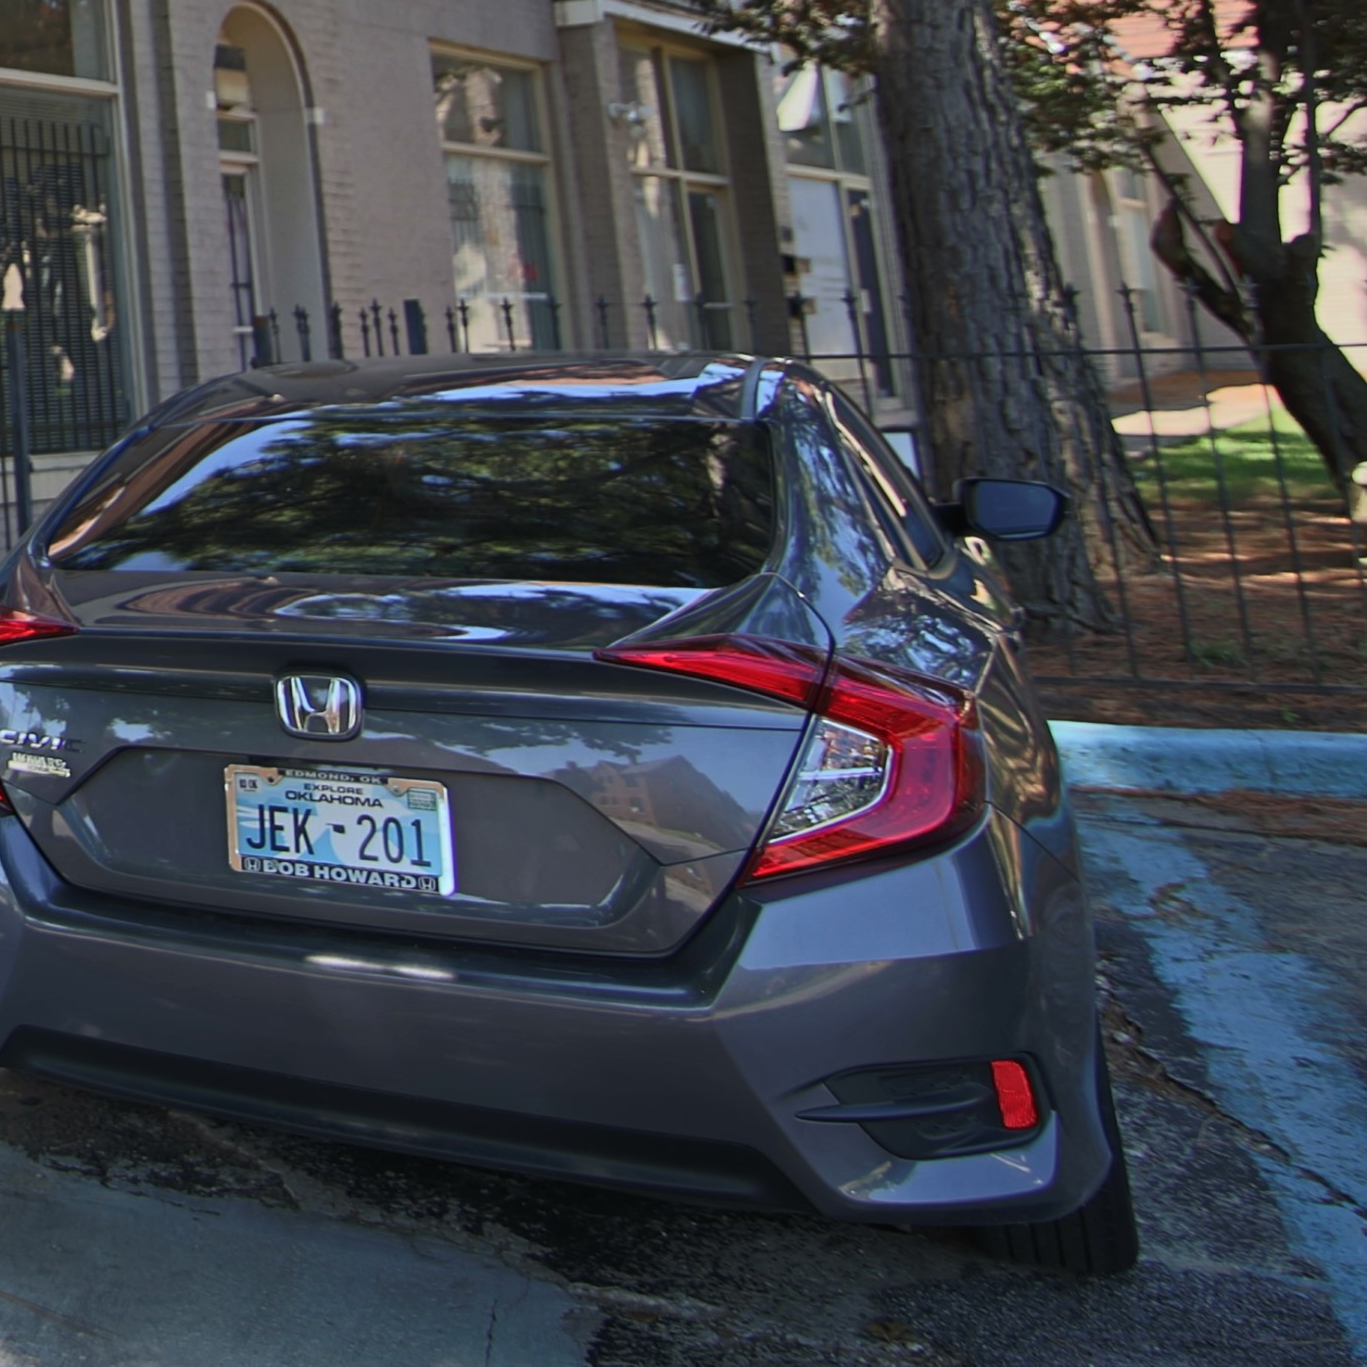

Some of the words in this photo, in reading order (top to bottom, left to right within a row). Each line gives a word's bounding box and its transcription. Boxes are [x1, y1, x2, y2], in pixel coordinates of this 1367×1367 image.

[285, 768, 354, 782] EDMOND,
[359, 775, 383, 784] OK
[303, 783, 364, 795] EXPLORE
[285, 790, 383, 808] OKLAHOMA
[246, 804, 315, 856] JEK
[356, 814, 432, 868] 201
[263, 859, 310, 878] BOB
[313, 865, 417, 890] HOWARD
